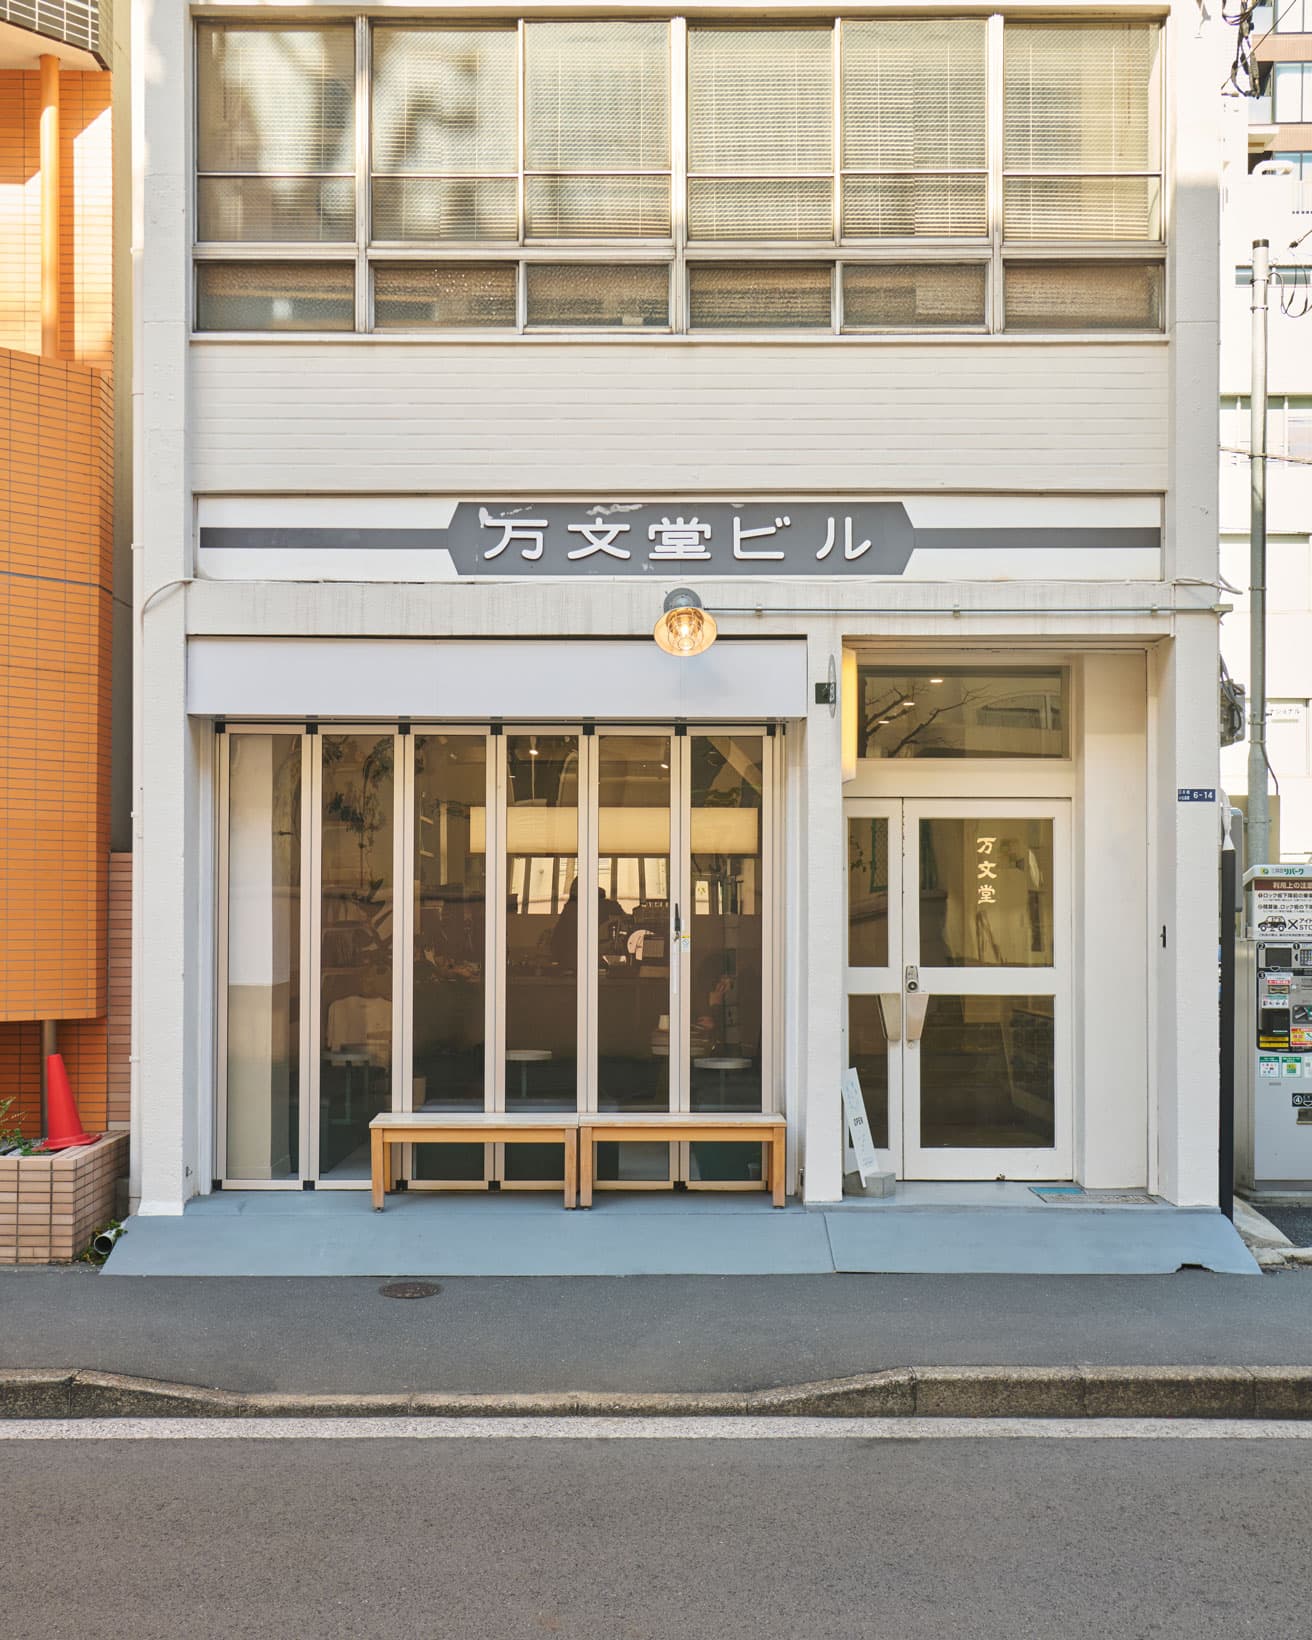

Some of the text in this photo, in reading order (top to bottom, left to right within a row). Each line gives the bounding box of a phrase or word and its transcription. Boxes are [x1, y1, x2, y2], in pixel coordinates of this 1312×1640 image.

[483, 516, 872, 561] 万文堂ビル
[1193, 791, 1213, 799] 6-14
[976, 837, 998, 904] 万文堂
